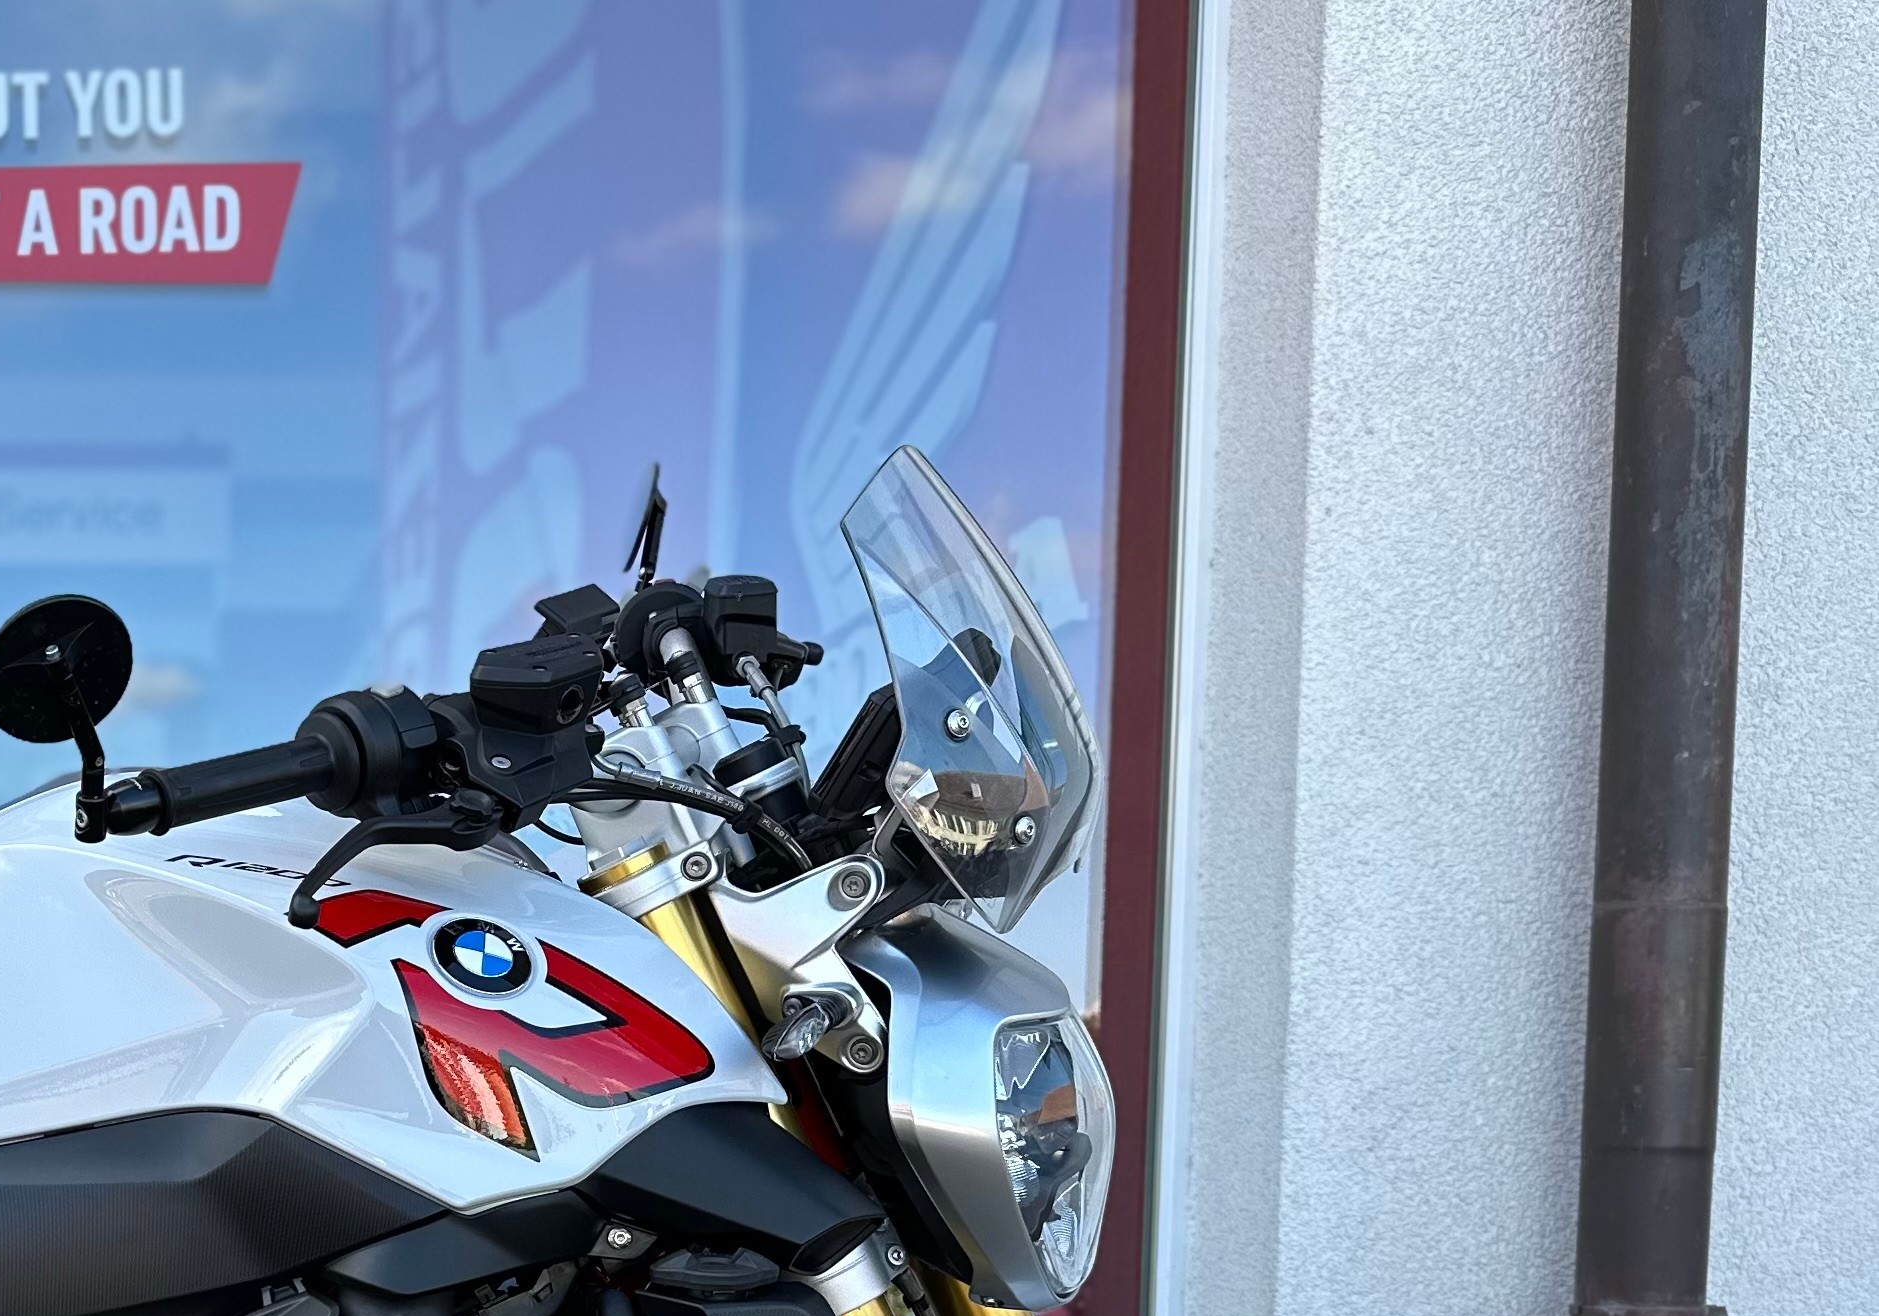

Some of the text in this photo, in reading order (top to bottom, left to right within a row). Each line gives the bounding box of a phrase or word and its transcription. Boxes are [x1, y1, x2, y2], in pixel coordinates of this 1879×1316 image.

[66, 67, 184, 140] YOU
[17, 188, 59, 256] A
[79, 184, 241, 255] ROAD
